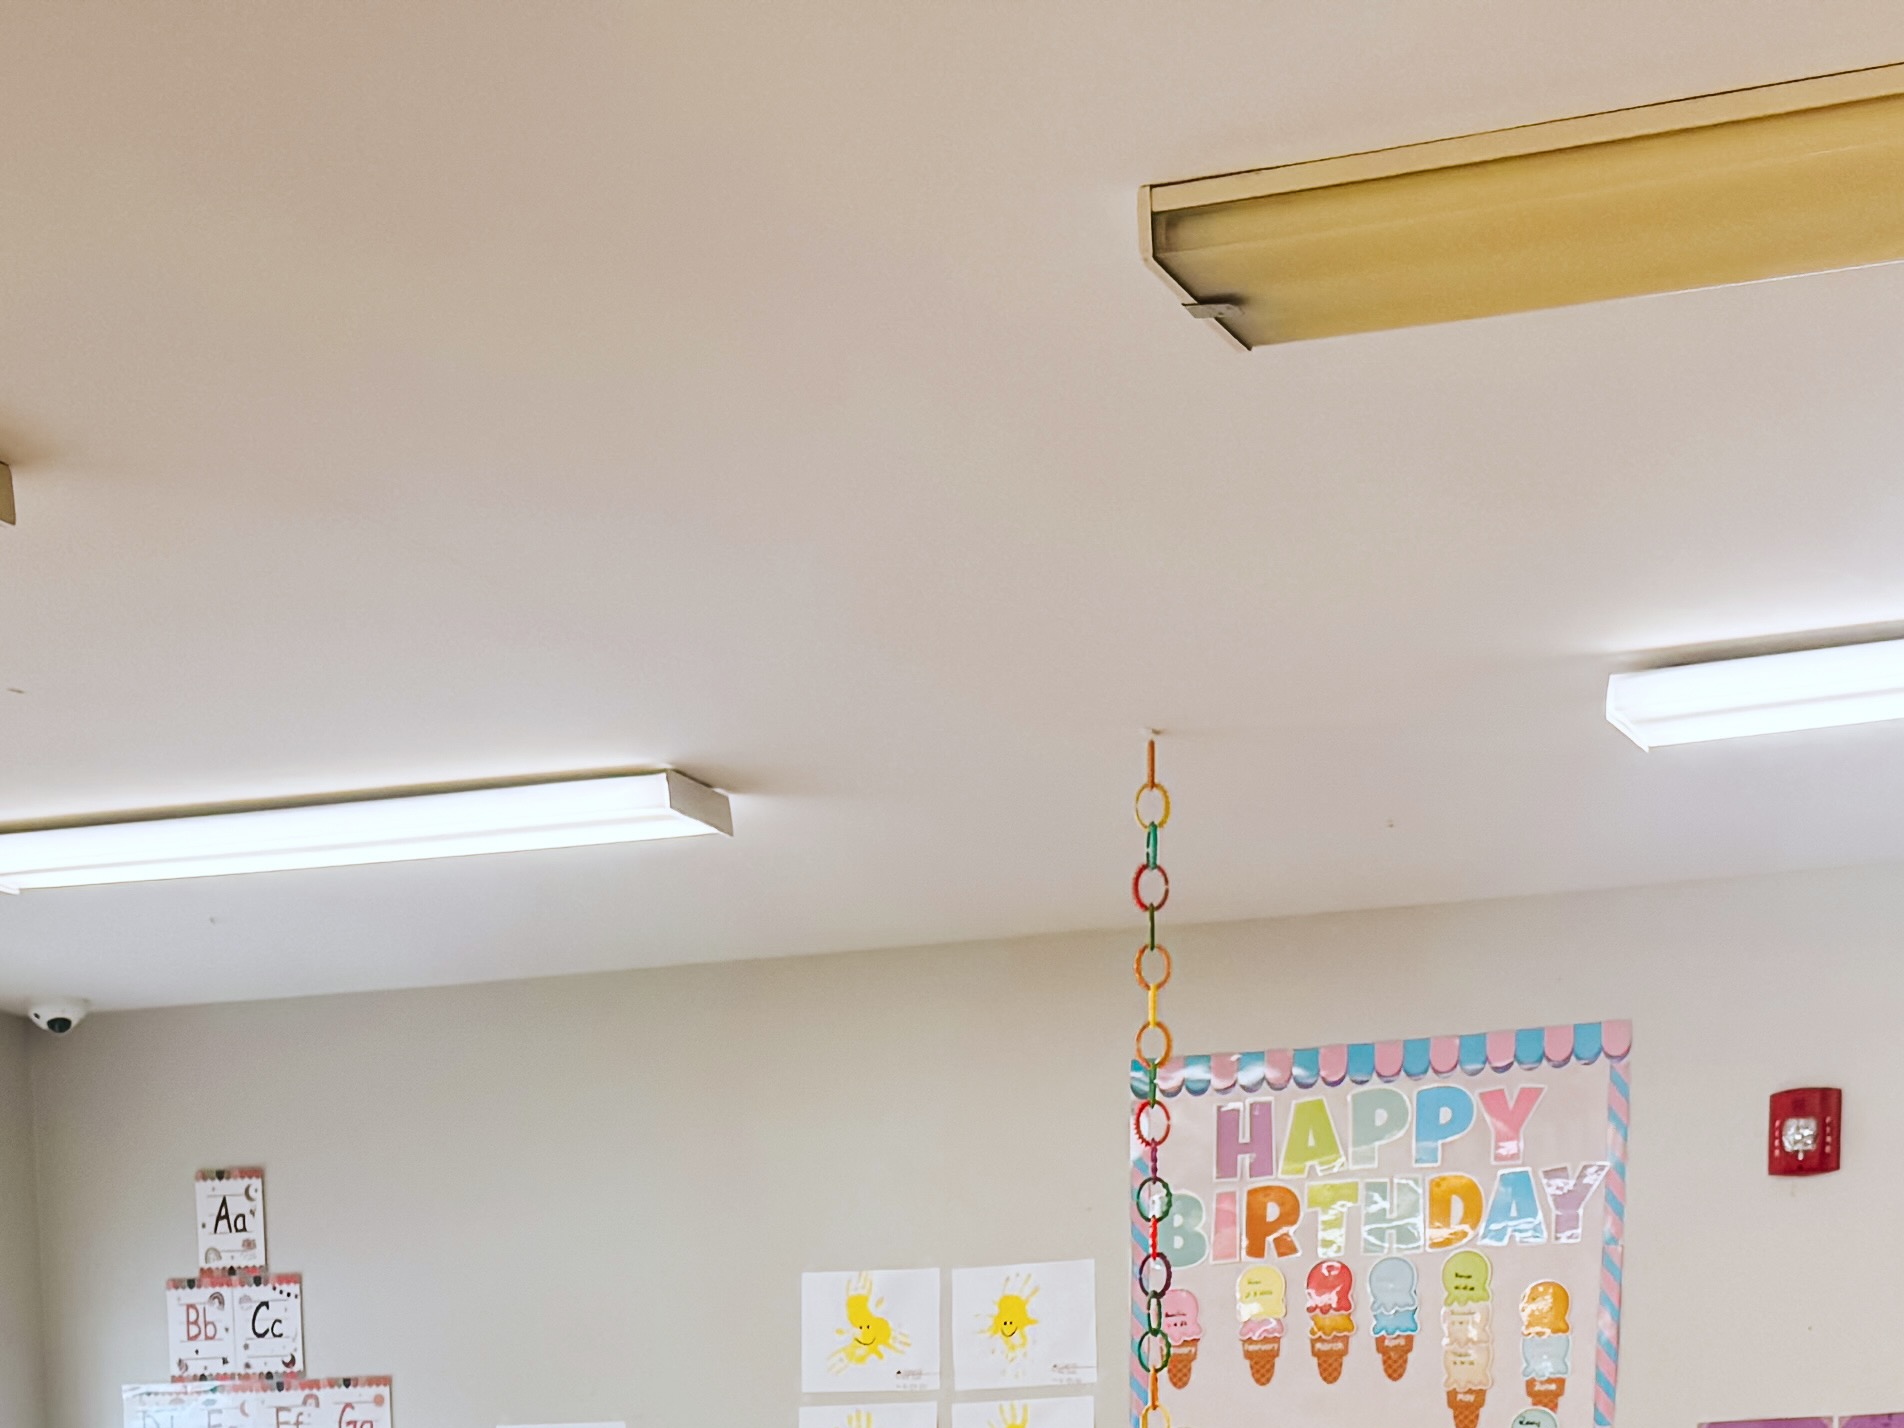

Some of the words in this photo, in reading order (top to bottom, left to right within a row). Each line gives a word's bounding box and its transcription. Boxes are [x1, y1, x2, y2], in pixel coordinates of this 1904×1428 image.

[1214, 1085, 1546, 1181] HAPPY
[213, 1195, 247, 1235] Aa
[1159, 1162, 1612, 1269] BIRTHDAY
[185, 1303, 218, 1343] Bb
[251, 1301, 284, 1340] Cc
